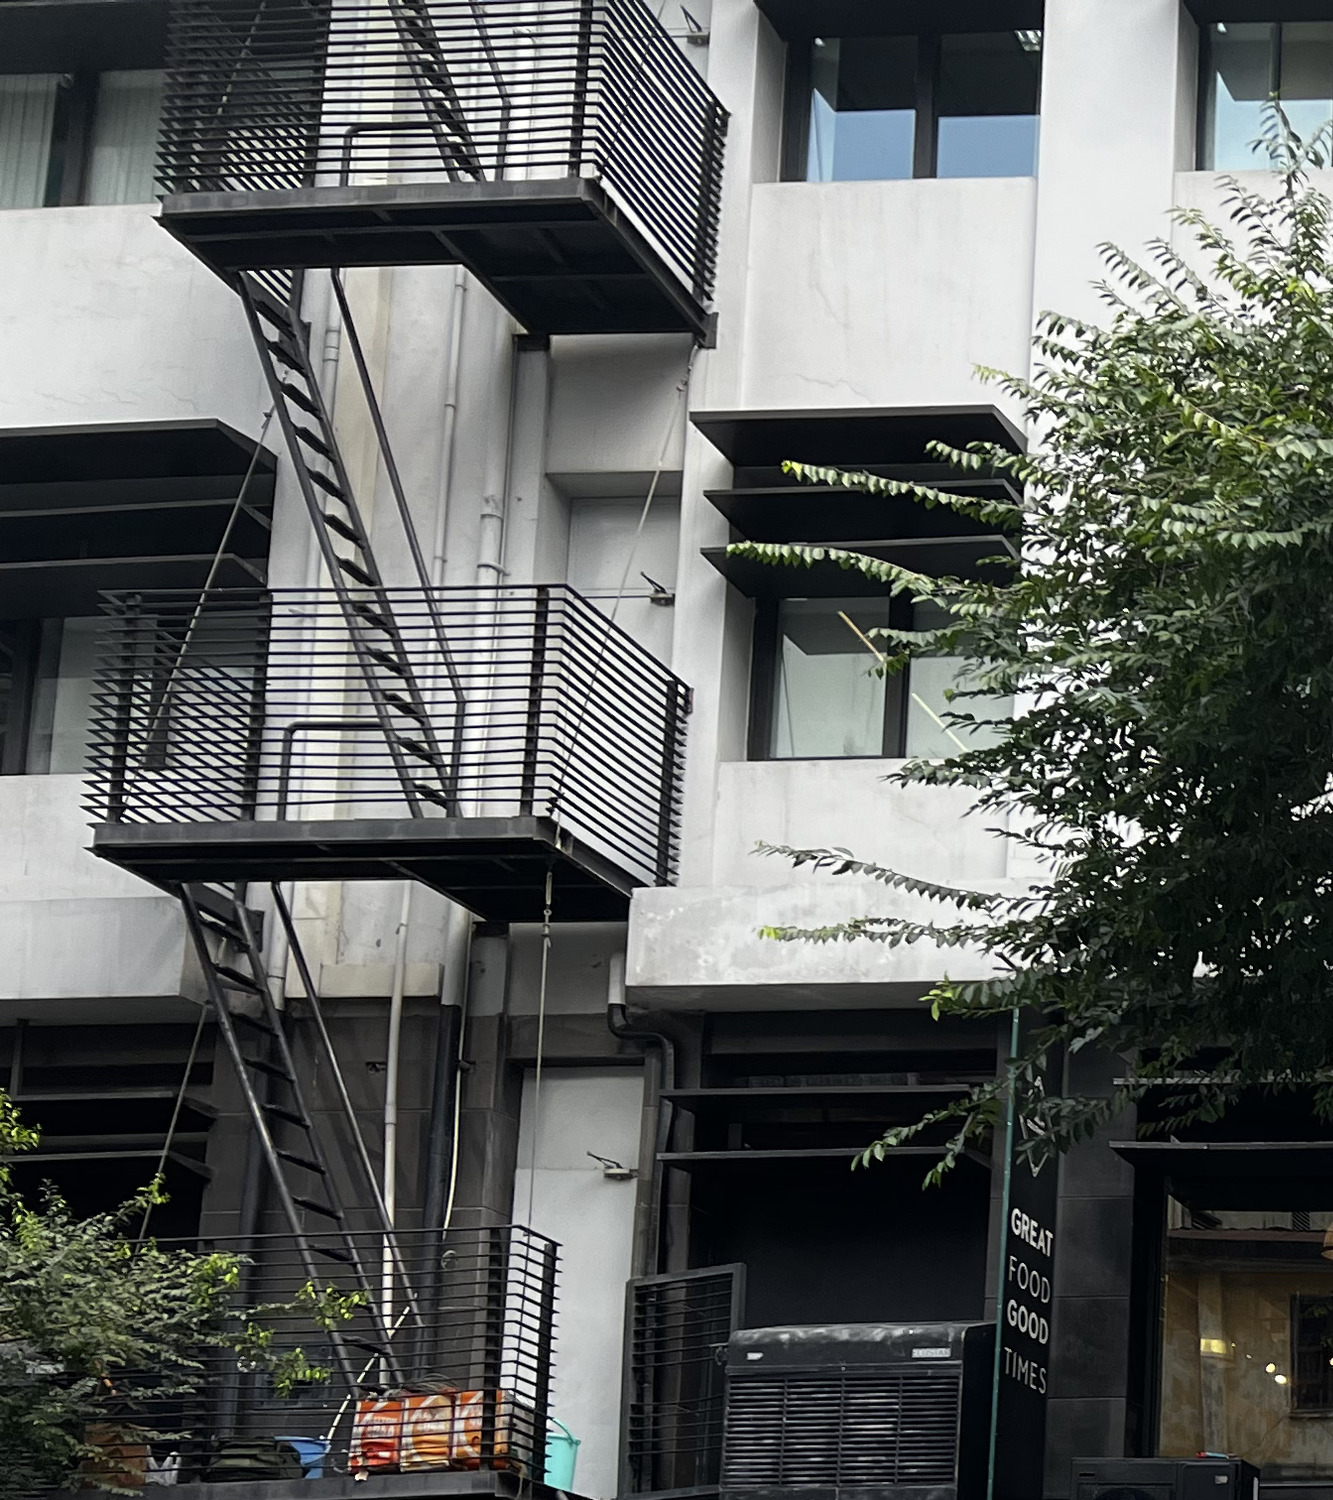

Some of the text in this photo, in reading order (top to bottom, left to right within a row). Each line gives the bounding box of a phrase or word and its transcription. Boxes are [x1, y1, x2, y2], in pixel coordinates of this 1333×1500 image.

[1011, 1208, 1053, 1257] GREAT
[1009, 1255, 1050, 1304] FOOD
[1007, 1299, 1049, 1345] GOOD
[1004, 1347, 1046, 1394] TIMES
